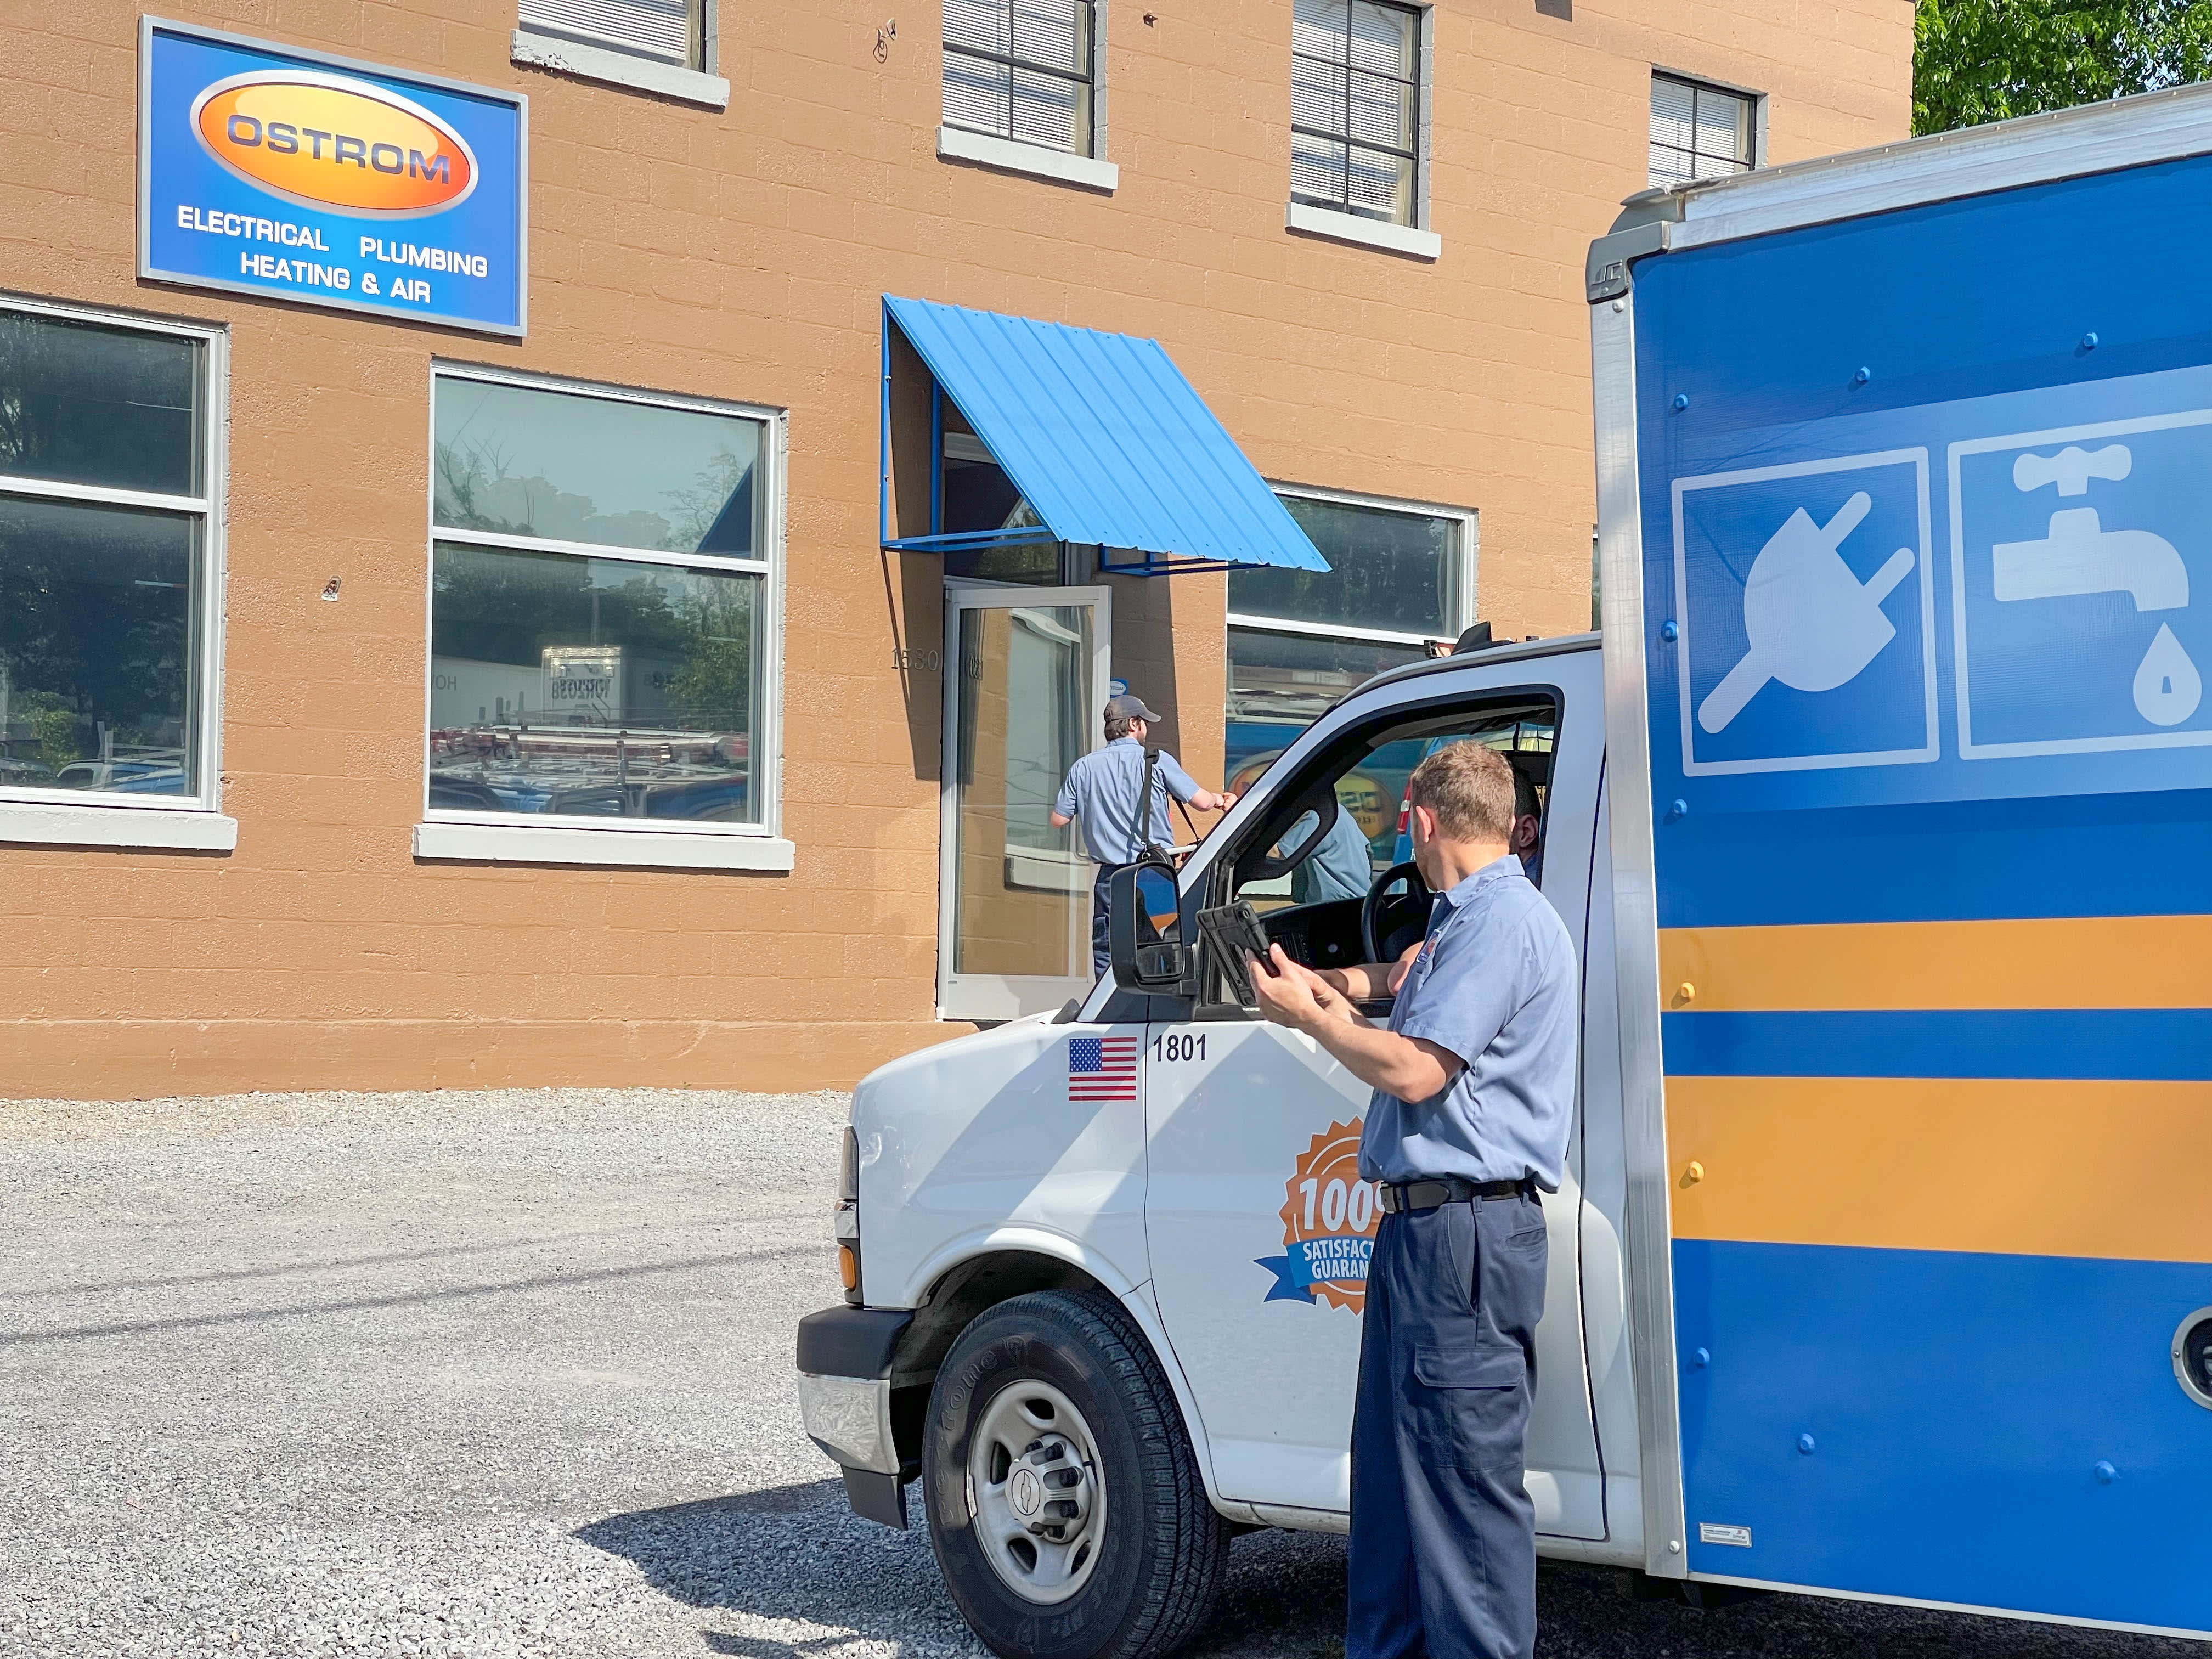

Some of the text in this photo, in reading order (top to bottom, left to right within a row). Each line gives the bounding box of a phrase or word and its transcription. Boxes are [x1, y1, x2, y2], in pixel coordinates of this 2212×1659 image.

[228, 114, 449, 184] OSTROM
[178, 204, 488, 278] ELECTRICAL PLUMBING
[241, 251, 431, 303] HEATING & AIR
[891, 648, 939, 672] 1530
[1153, 1034, 1206, 1062] 1801
